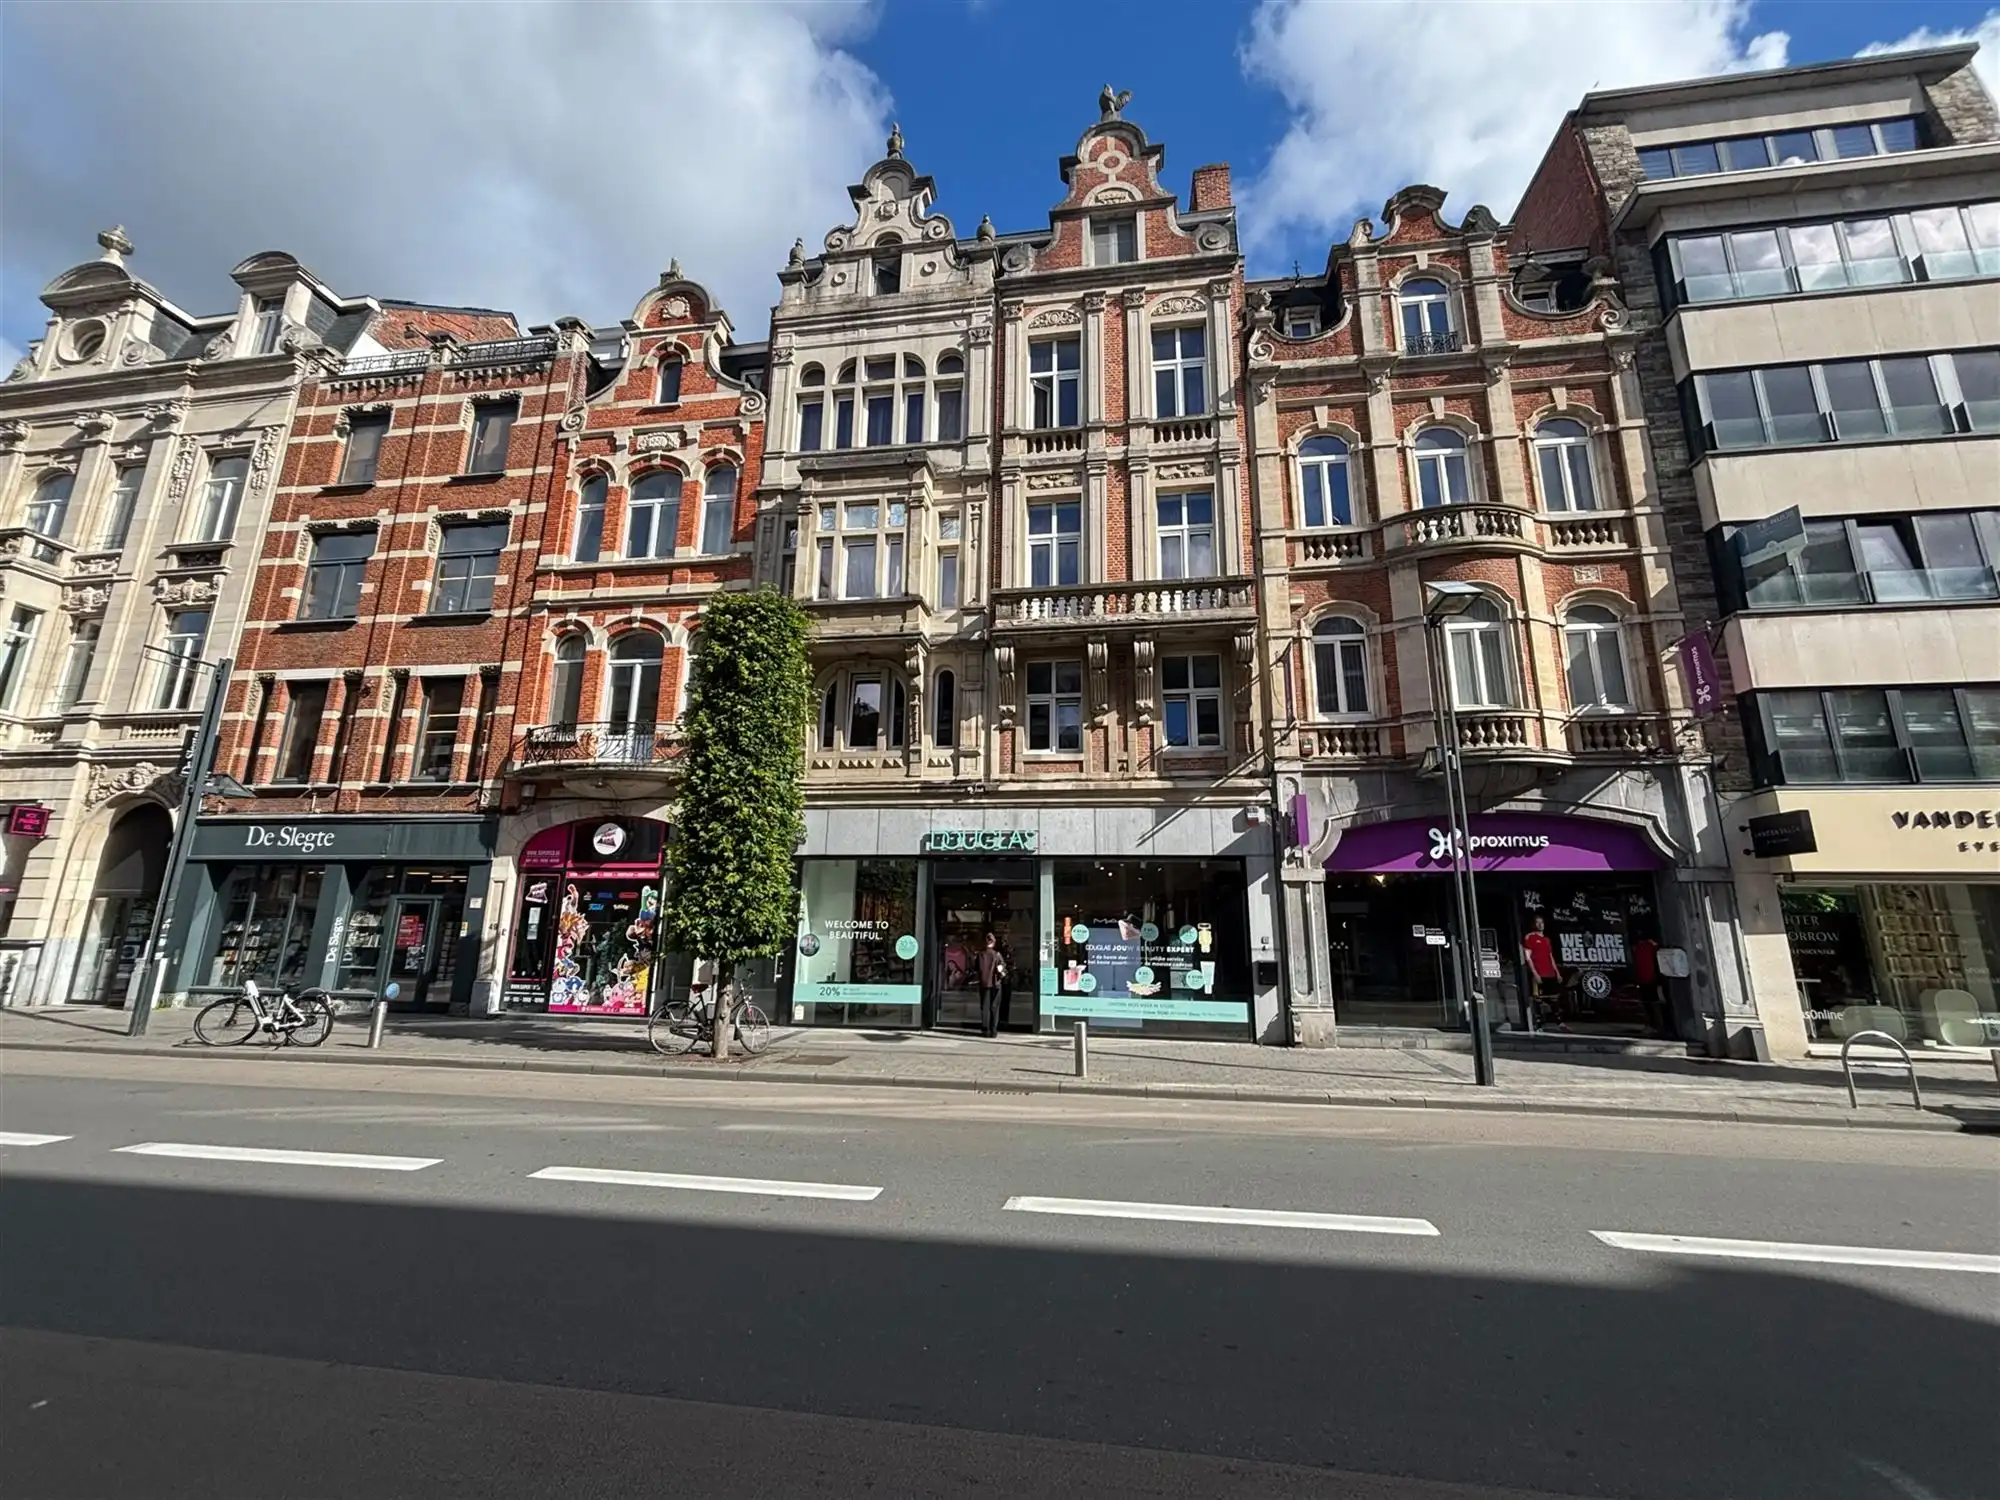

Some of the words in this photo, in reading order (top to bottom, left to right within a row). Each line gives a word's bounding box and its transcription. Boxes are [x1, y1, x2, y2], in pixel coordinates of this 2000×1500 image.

[245, 825, 275, 846] De
[277, 825, 335, 853] Slegte
[930, 829, 1038, 850] DOUGLAS
[1470, 835, 1550, 851] proximus
[825, 920, 873, 929] WELCOME
[876, 921, 889, 930] TO
[828, 931, 883, 940] BEAUTIFUL.
[1559, 933, 1583, 948] WE
[1595, 933, 1624, 948] ARE
[1561, 948, 1626, 962] BELGIUM
[819, 986, 841, 997] 20%
